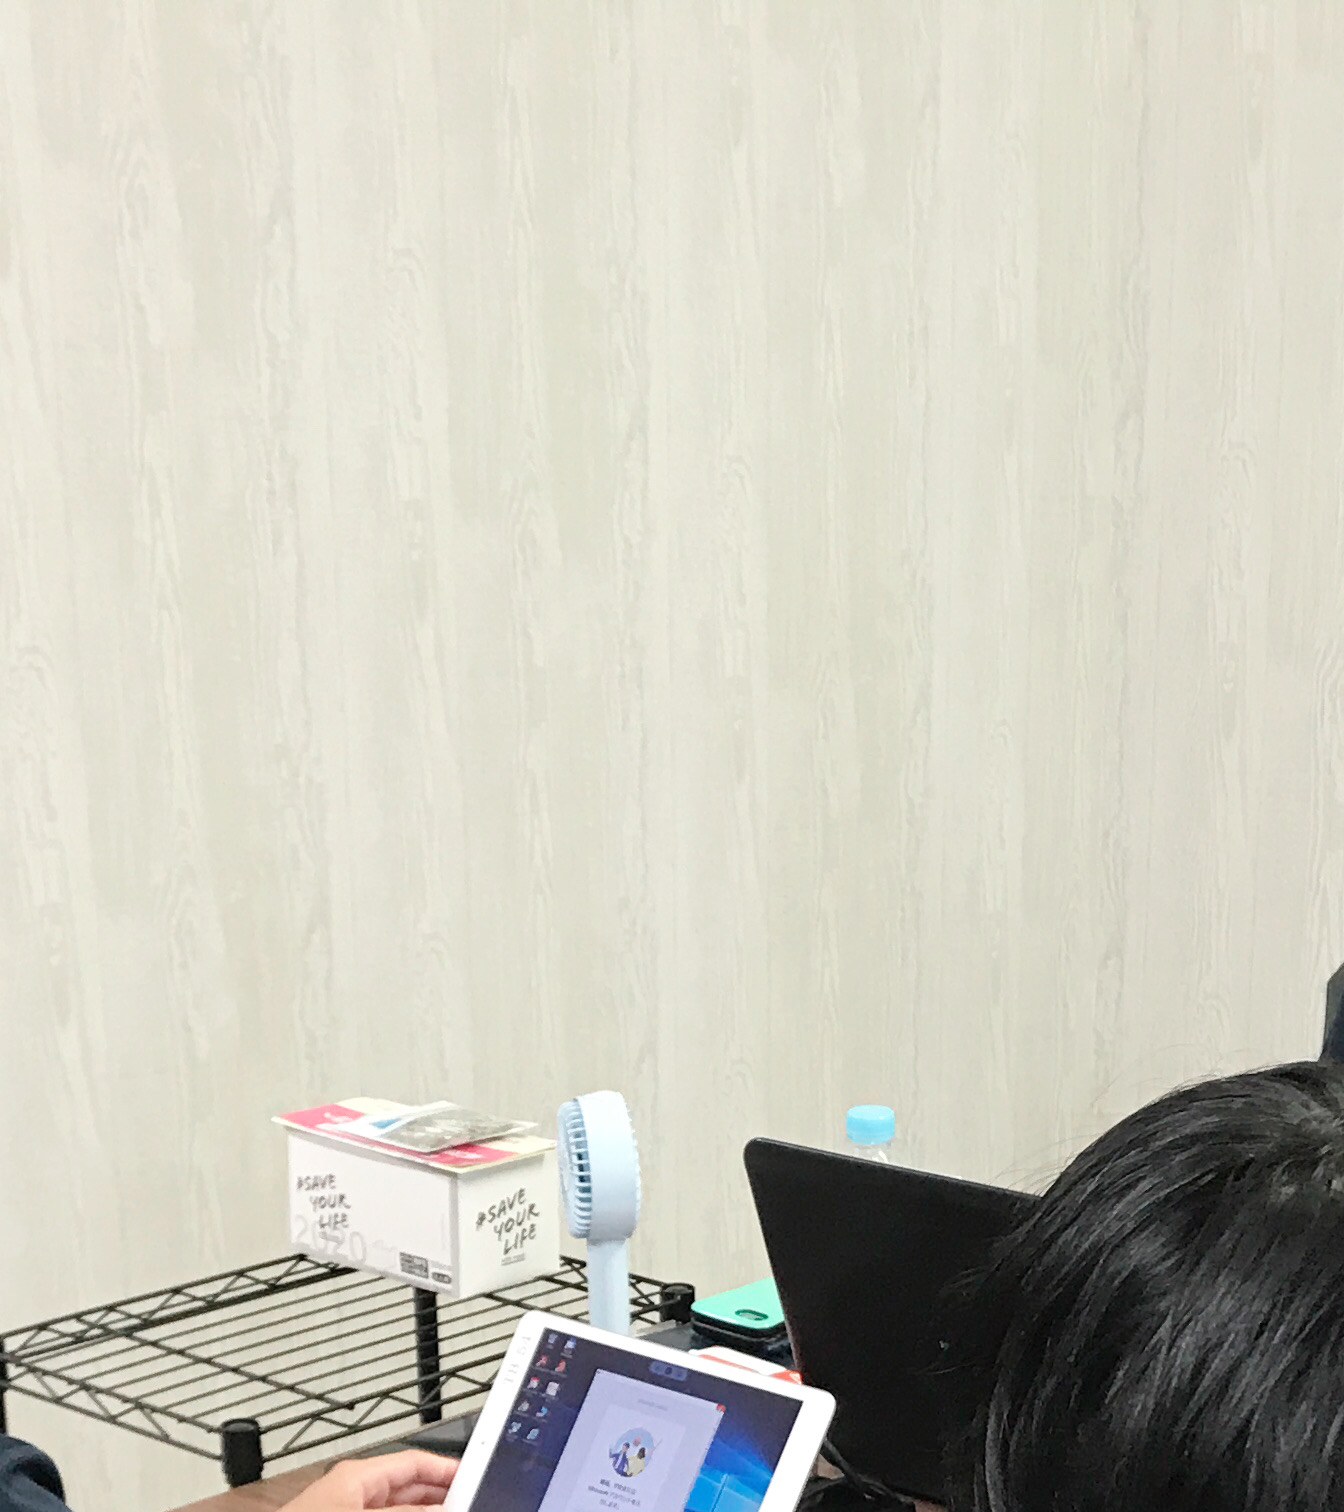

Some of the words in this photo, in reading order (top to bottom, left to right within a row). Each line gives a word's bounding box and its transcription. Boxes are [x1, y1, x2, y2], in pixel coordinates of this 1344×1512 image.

[309, 1193, 351, 1212] YOUR
[476, 1188, 525, 1230] #SAVE
[319, 1212, 348, 1230] LIFE
[493, 1203, 540, 1241] YOUR
[503, 1223, 536, 1255] LIFE
